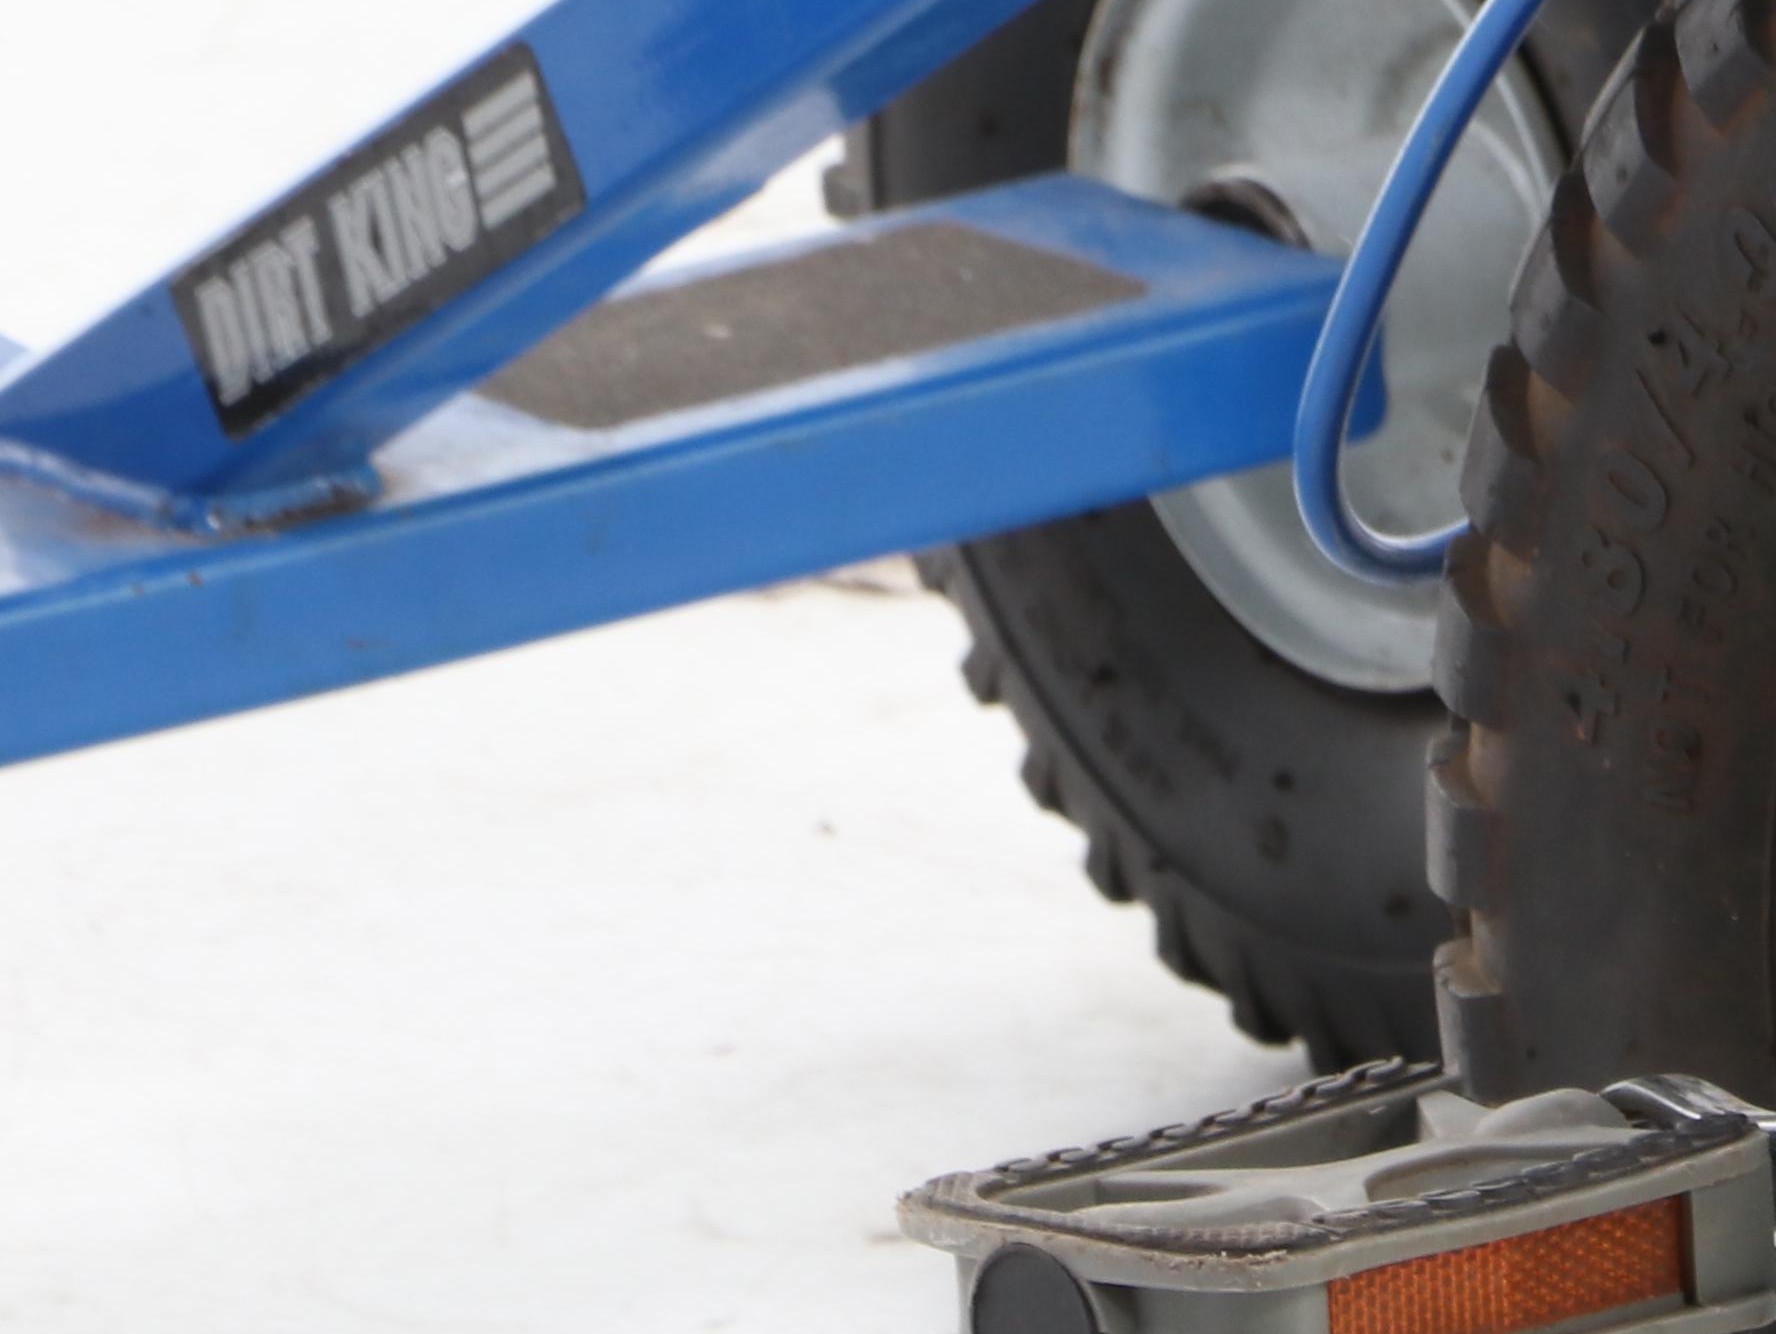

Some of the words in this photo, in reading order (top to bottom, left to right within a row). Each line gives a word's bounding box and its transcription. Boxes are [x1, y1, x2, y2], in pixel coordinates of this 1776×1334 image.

[194, 214, 334, 407] DIRT
[326, 125, 479, 318] KING
[1673, 513, 1756, 647] FOR
